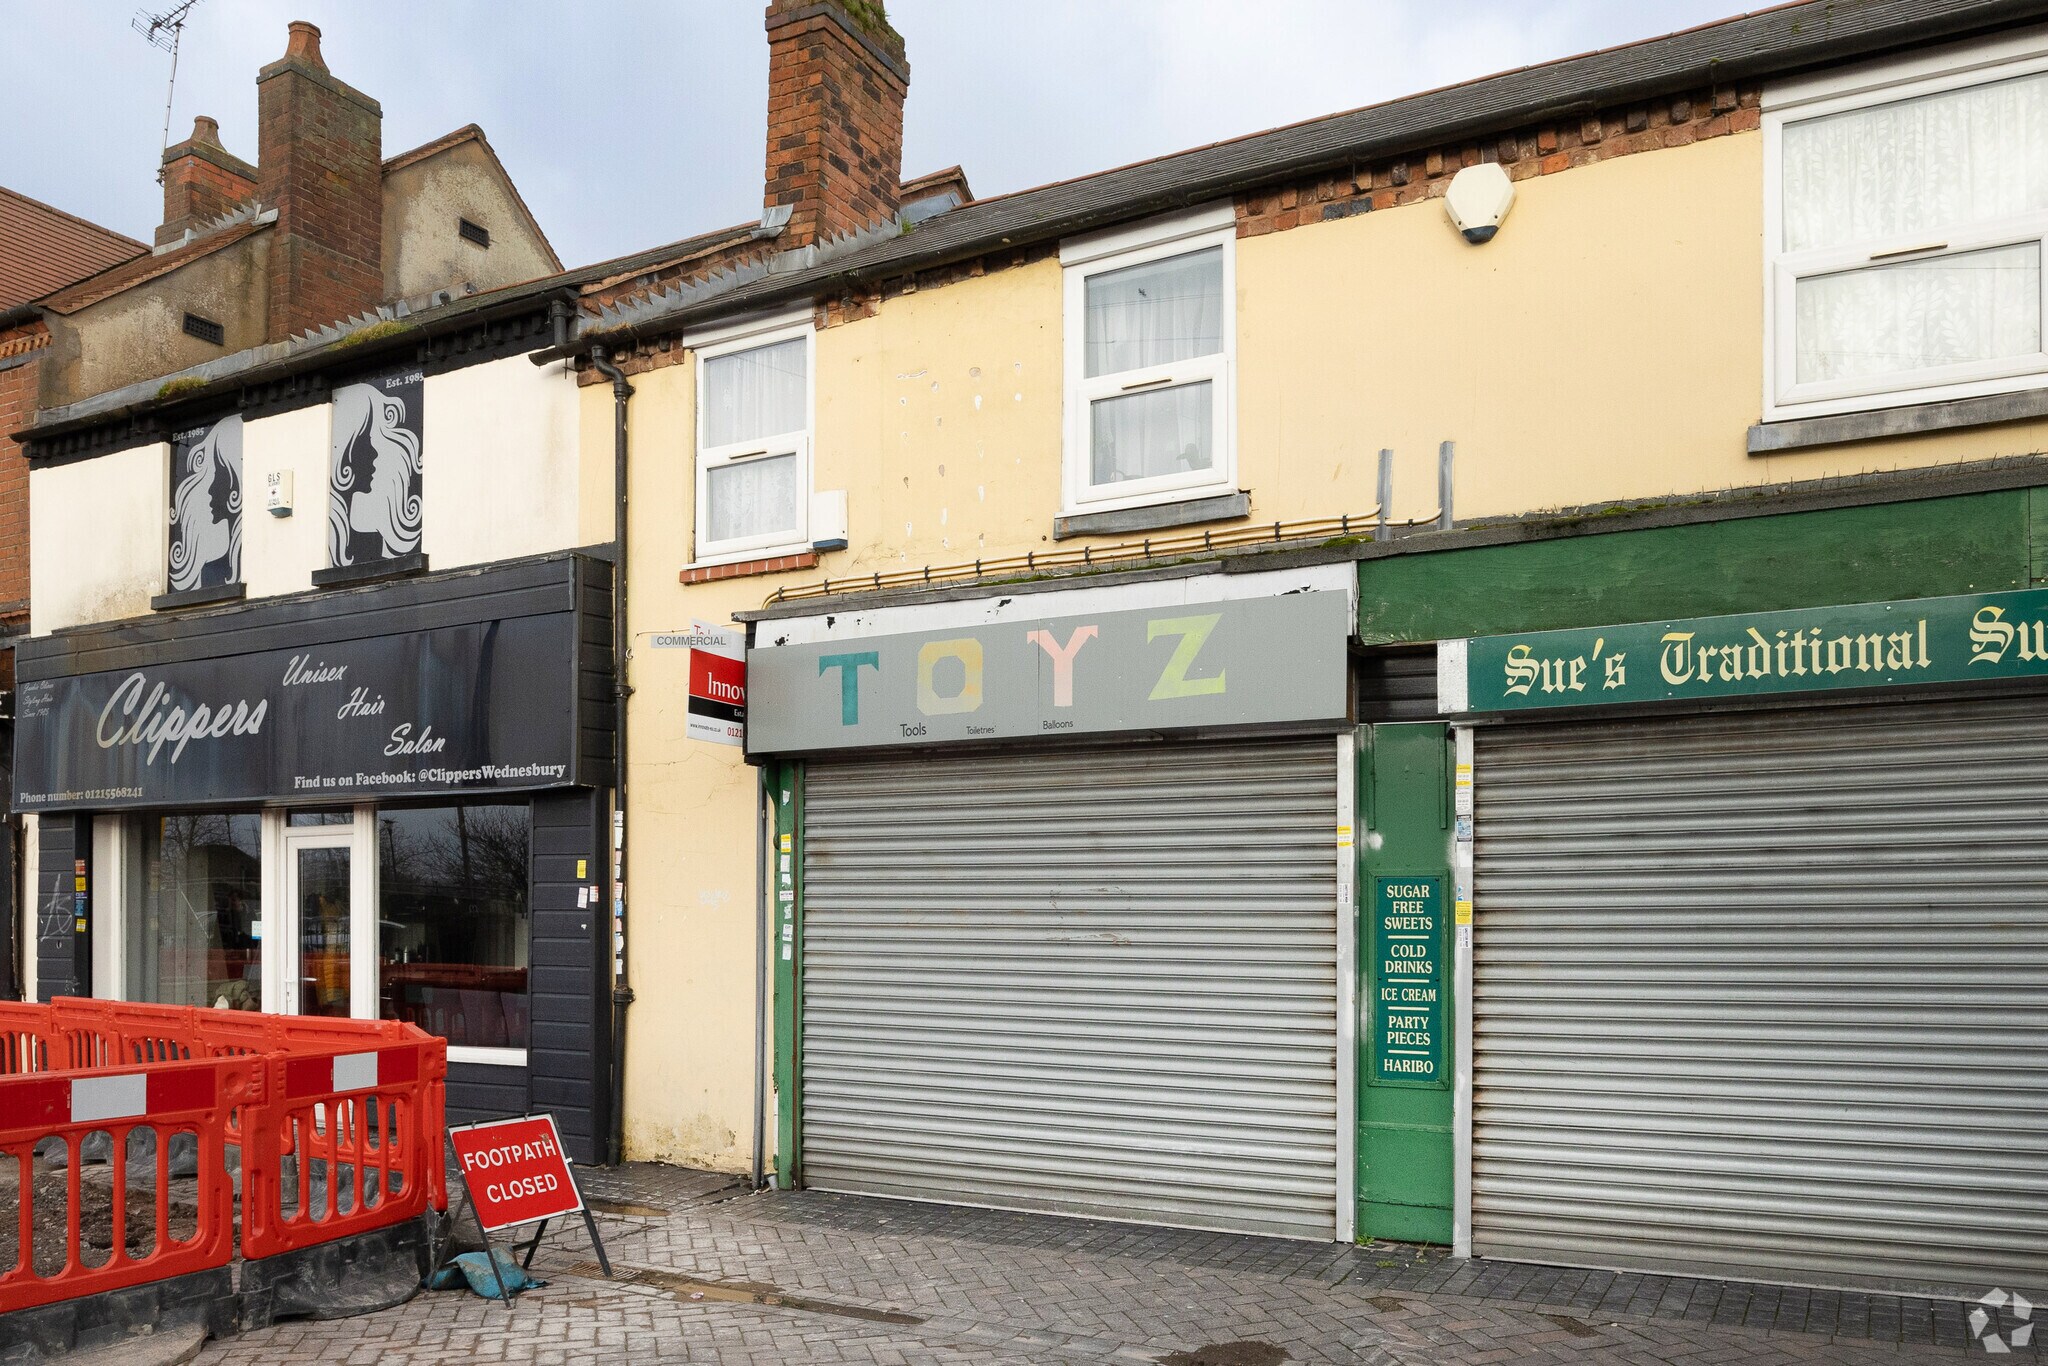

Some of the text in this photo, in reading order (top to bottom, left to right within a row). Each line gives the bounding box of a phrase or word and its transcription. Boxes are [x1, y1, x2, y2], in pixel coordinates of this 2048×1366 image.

[386, 378, 402, 388] Est.
[187, 427, 205, 438] 1985
[268, 472, 280, 482] GLS
[657, 636, 727, 646] COMMERCIAL
[1503, 606, 2048, 697] Sue's Traditional Su
[283, 653, 348, 686] Unisex
[337, 686, 385, 719] Hair
[96, 672, 268, 766] Clippers
[1042, 719, 1074, 730] Balloons
[900, 722, 927, 737] Tools
[966, 725, 995, 735] Toiletries
[383, 722, 446, 756] Salon
[294, 762, 567, 789] Find us on Facebook: @ClippersWednesbury
[20, 787, 143, 803] Phone number: 01215568241
[1386, 884, 1430, 898] SUGAR
[1392, 901, 1424, 914] FREE
[1384, 917, 1433, 930] SWEETS
[1390, 944, 1427, 958] COLD
[1385, 960, 1433, 974] DRINKS
[1381, 988, 1437, 1002] ICE CREAM
[1388, 1015, 1429, 1029] PARTY
[1386, 1032, 1431, 1046] PIECES
[1383, 1059, 1434, 1074] HARIBO
[463, 1140, 557, 1171] FOOTPATH
[486, 1173, 558, 1203] CLOSED
